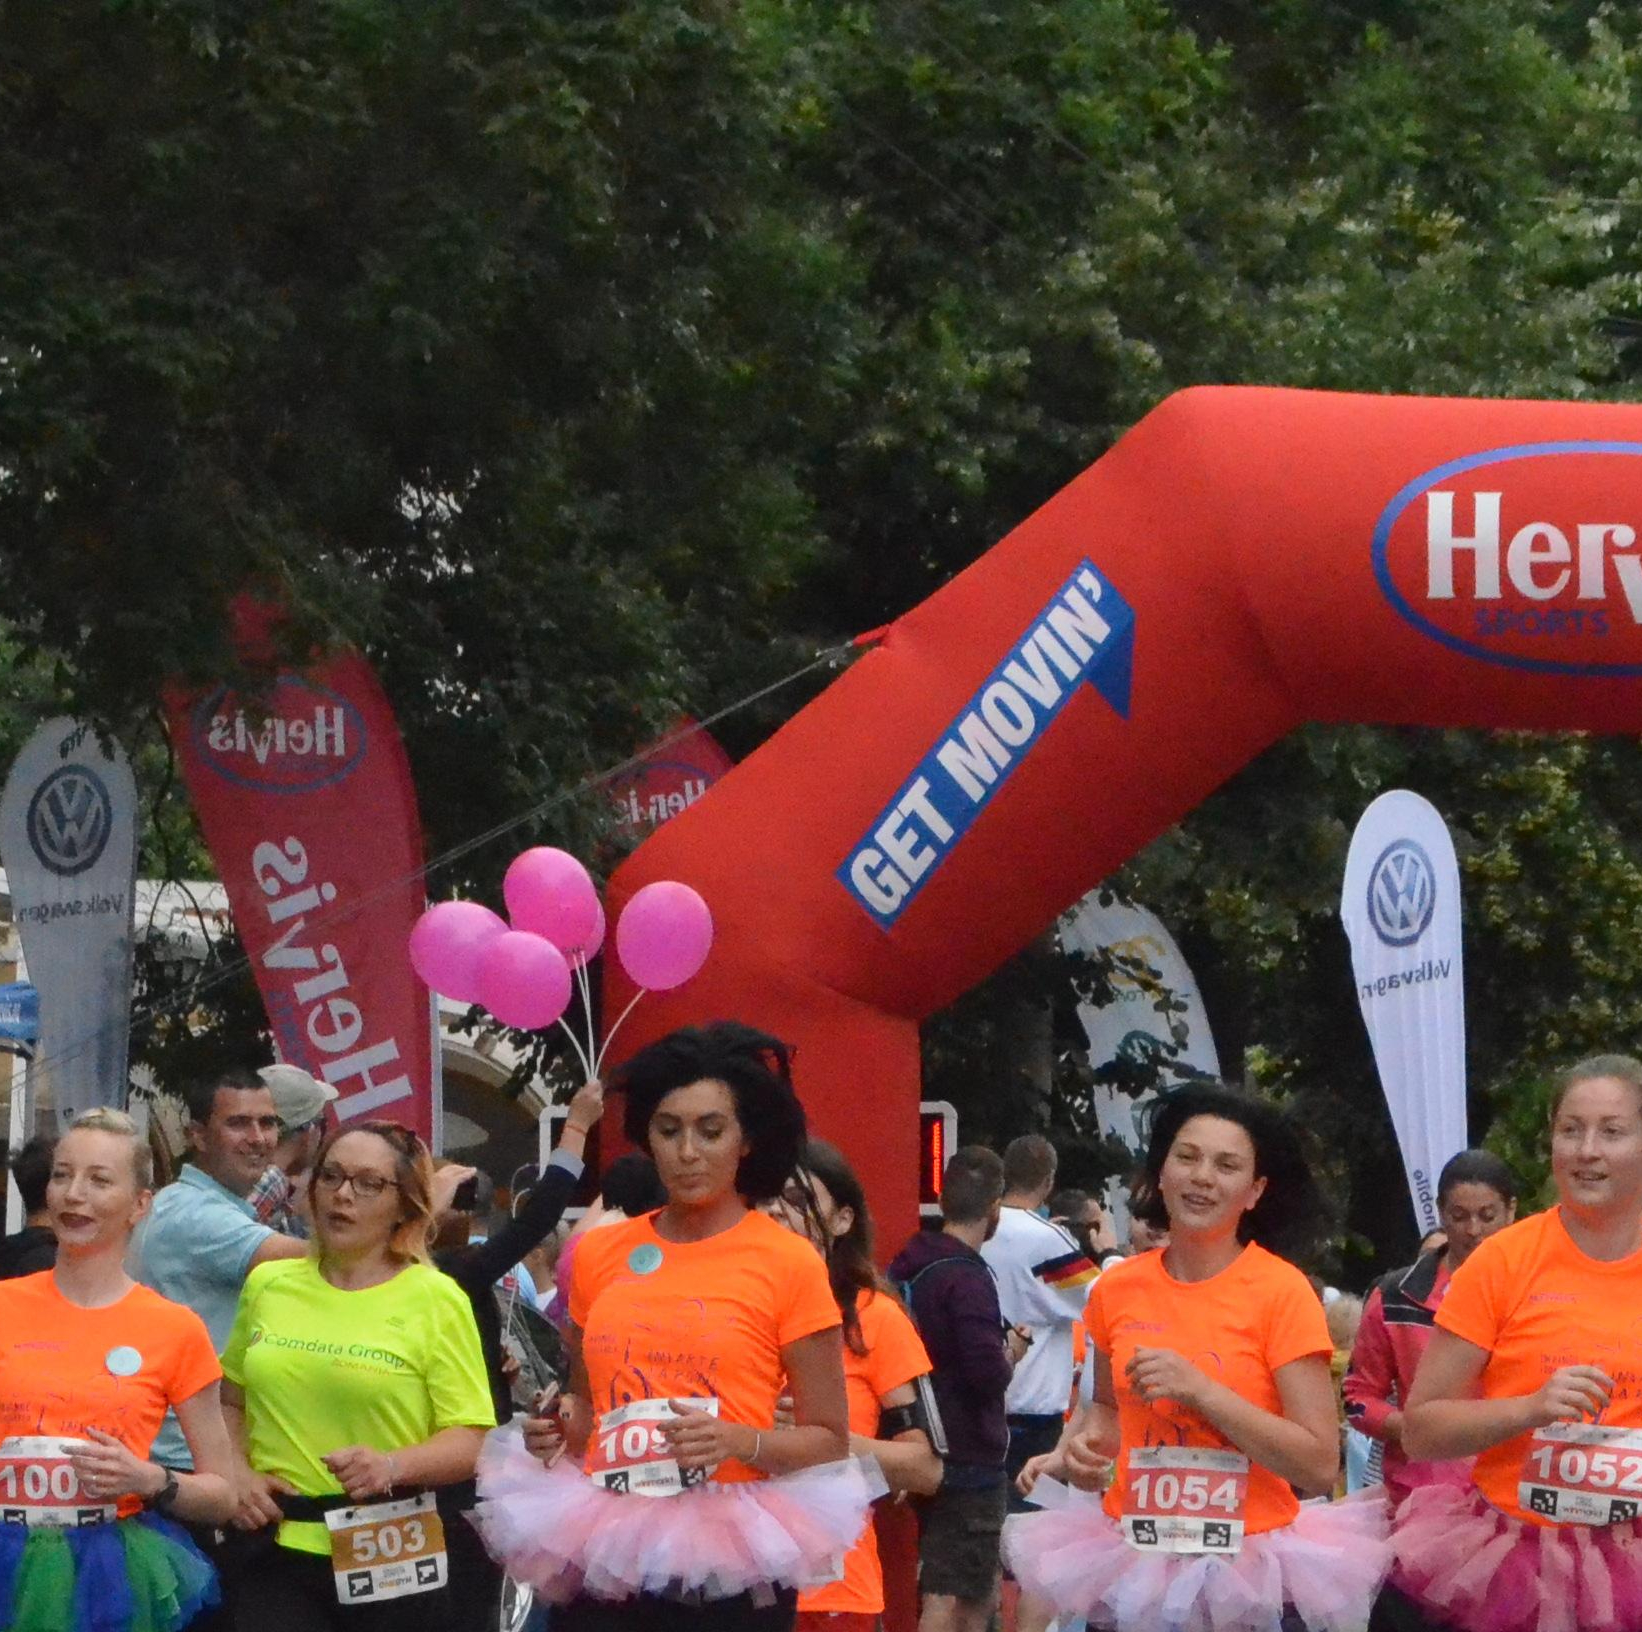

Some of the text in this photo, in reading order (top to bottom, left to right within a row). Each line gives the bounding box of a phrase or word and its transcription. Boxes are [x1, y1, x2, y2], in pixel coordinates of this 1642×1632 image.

[1473, 607, 1609, 637] SPORTS
[850, 775, 955, 915] GET
[264, 1333, 405, 1369] Comdata Group
[599, 1425, 671, 1464] 109
[1131, 1474, 1239, 1513] 1054
[352, 1520, 426, 1562] 503
